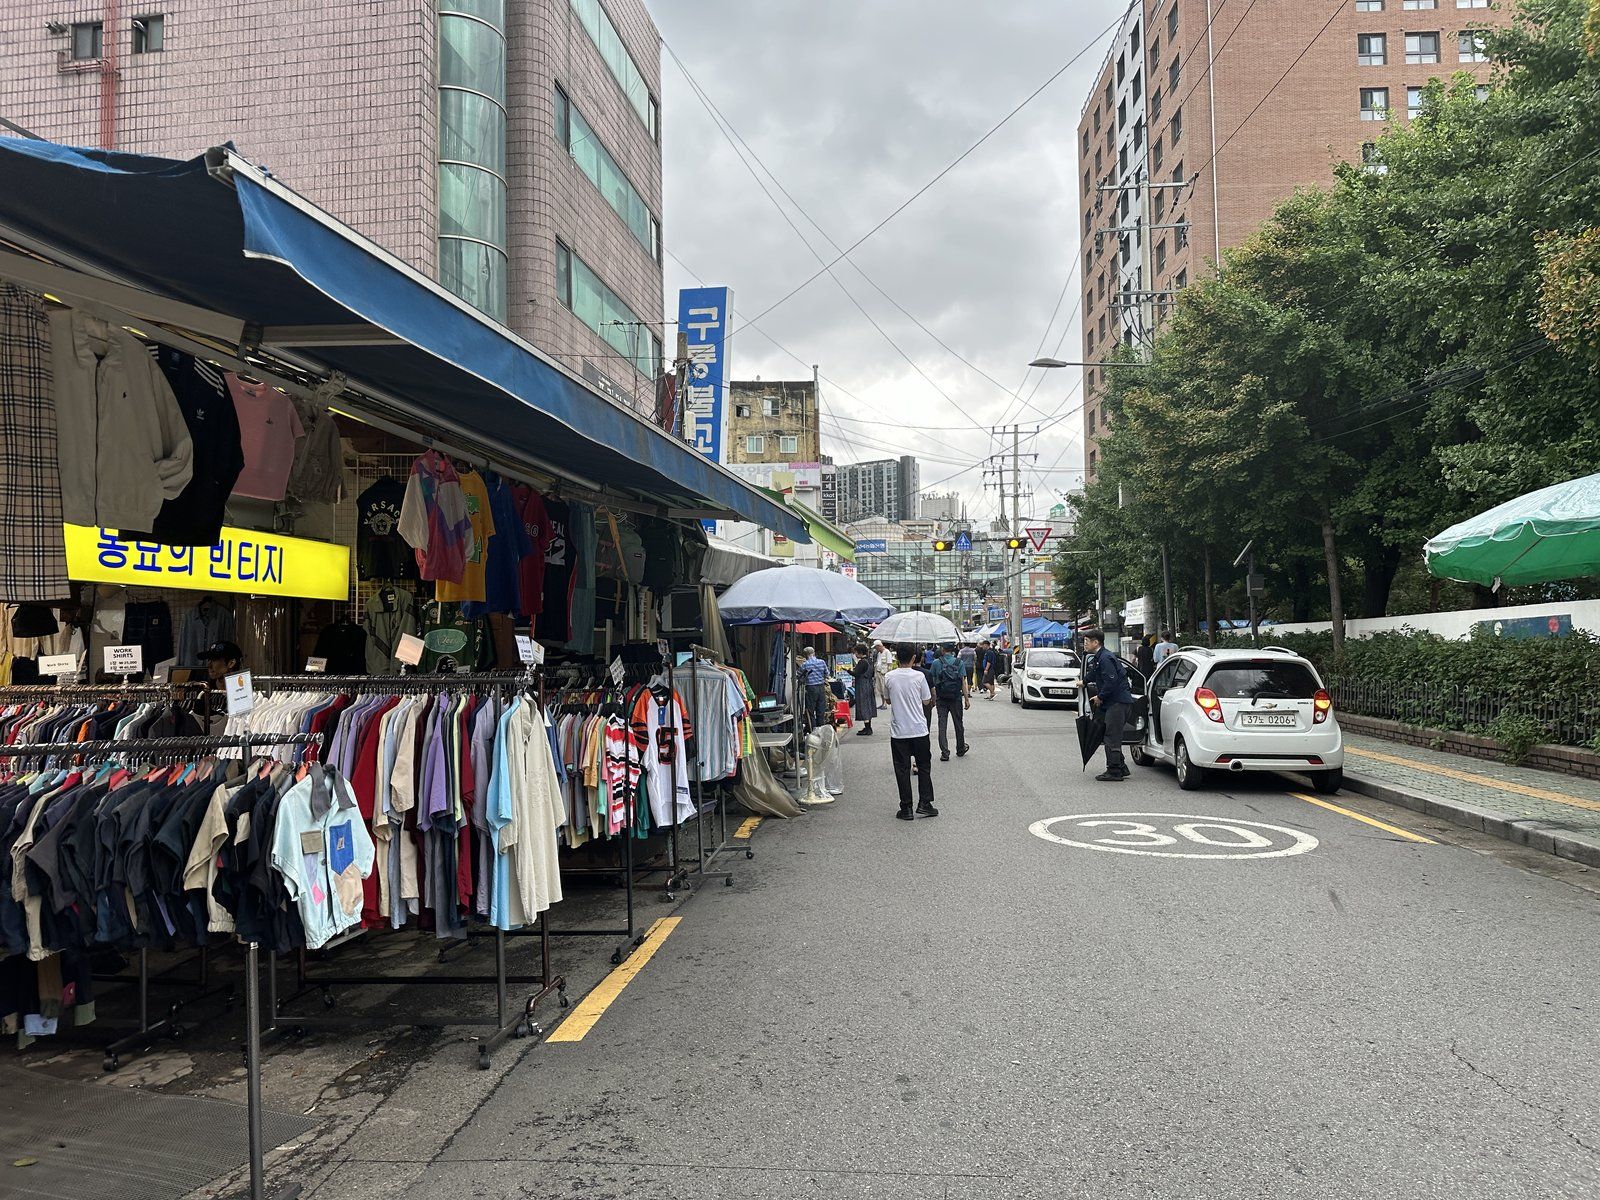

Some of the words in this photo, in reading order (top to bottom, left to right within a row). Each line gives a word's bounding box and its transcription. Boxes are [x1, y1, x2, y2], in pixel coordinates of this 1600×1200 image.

[97, 527, 194, 576] 동묘의
[209, 539, 283, 584] 빈티지
[1247, 716, 1264, 724] 37노
[1268, 715, 1291, 724] 0206
[1077, 820, 1273, 848] 30
